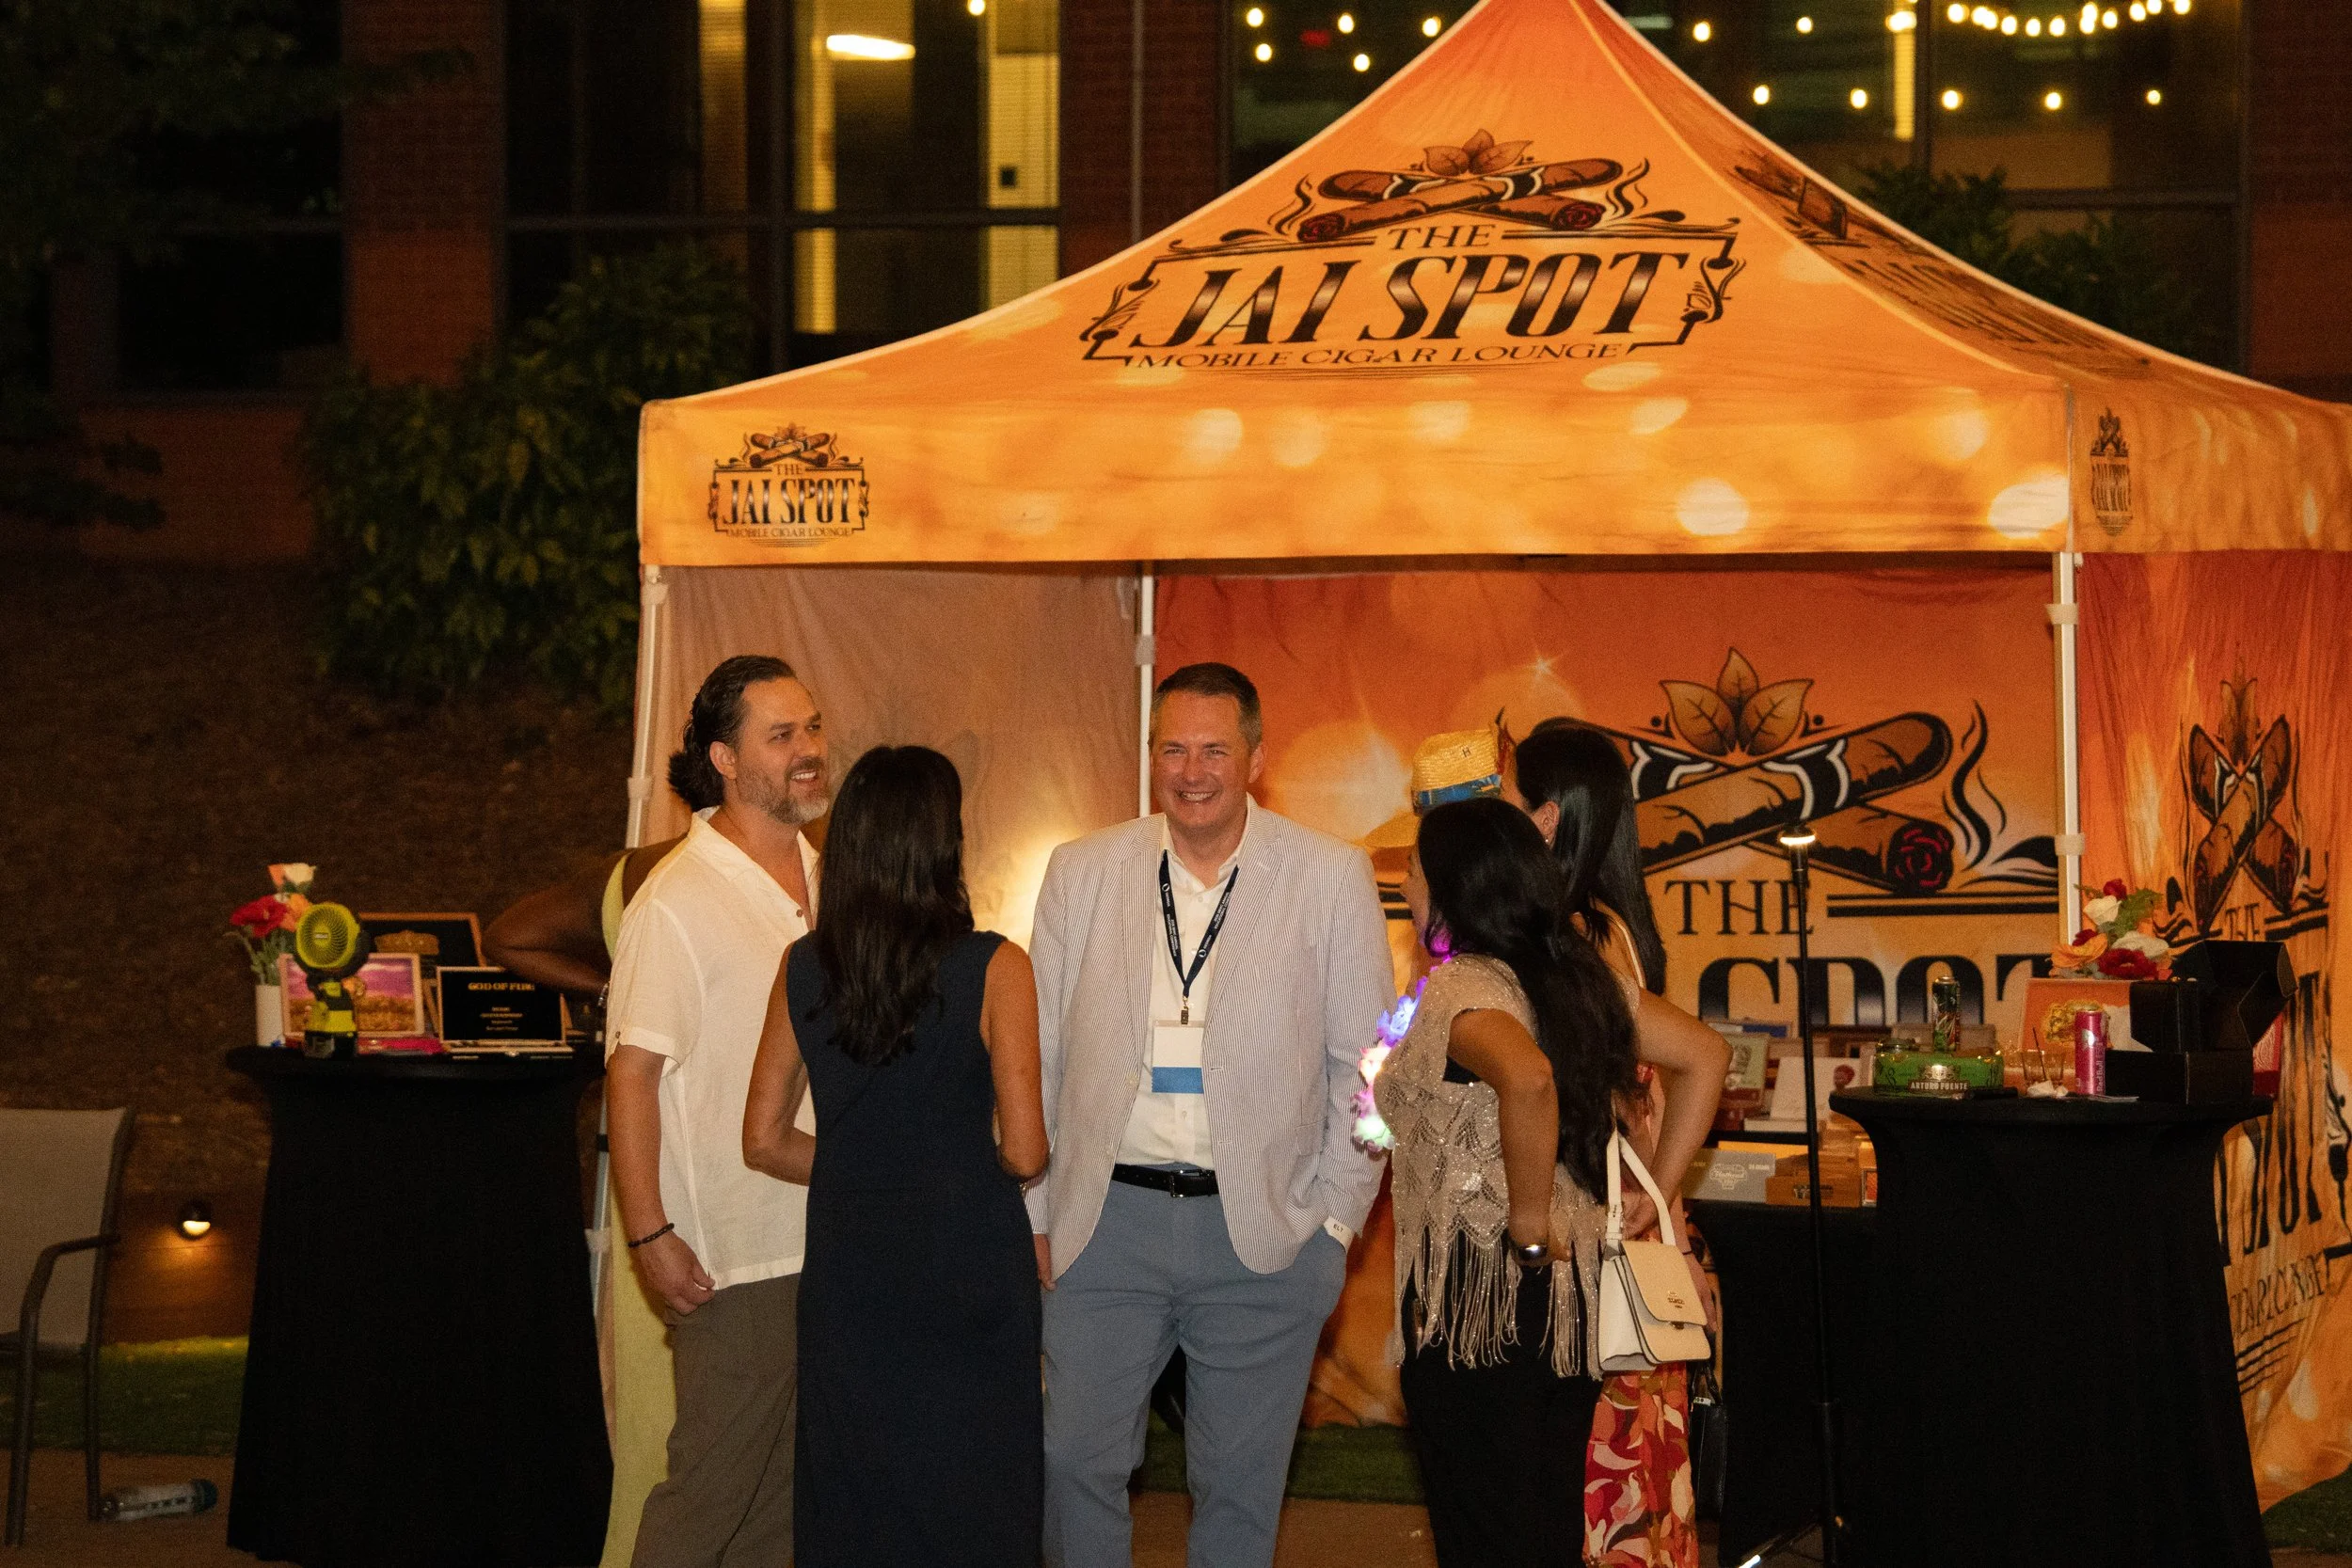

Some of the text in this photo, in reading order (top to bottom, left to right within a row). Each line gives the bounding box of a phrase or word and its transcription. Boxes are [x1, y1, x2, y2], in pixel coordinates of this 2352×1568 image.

[1388, 224, 1496, 250] THE
[1131, 251, 1692, 347] JAI SPOT
[1137, 343, 1622, 368] MOBILE CIGAR LOUNGE
[773, 464, 803, 475] THE
[723, 478, 855, 525] JAI SPOT
[728, 528, 768, 537] MOBILE
[809, 527, 851, 537] LOUNGE
[1665, 879, 1813, 936] THE
[1911, 1082, 1968, 1090] ARTURO FUENTE
